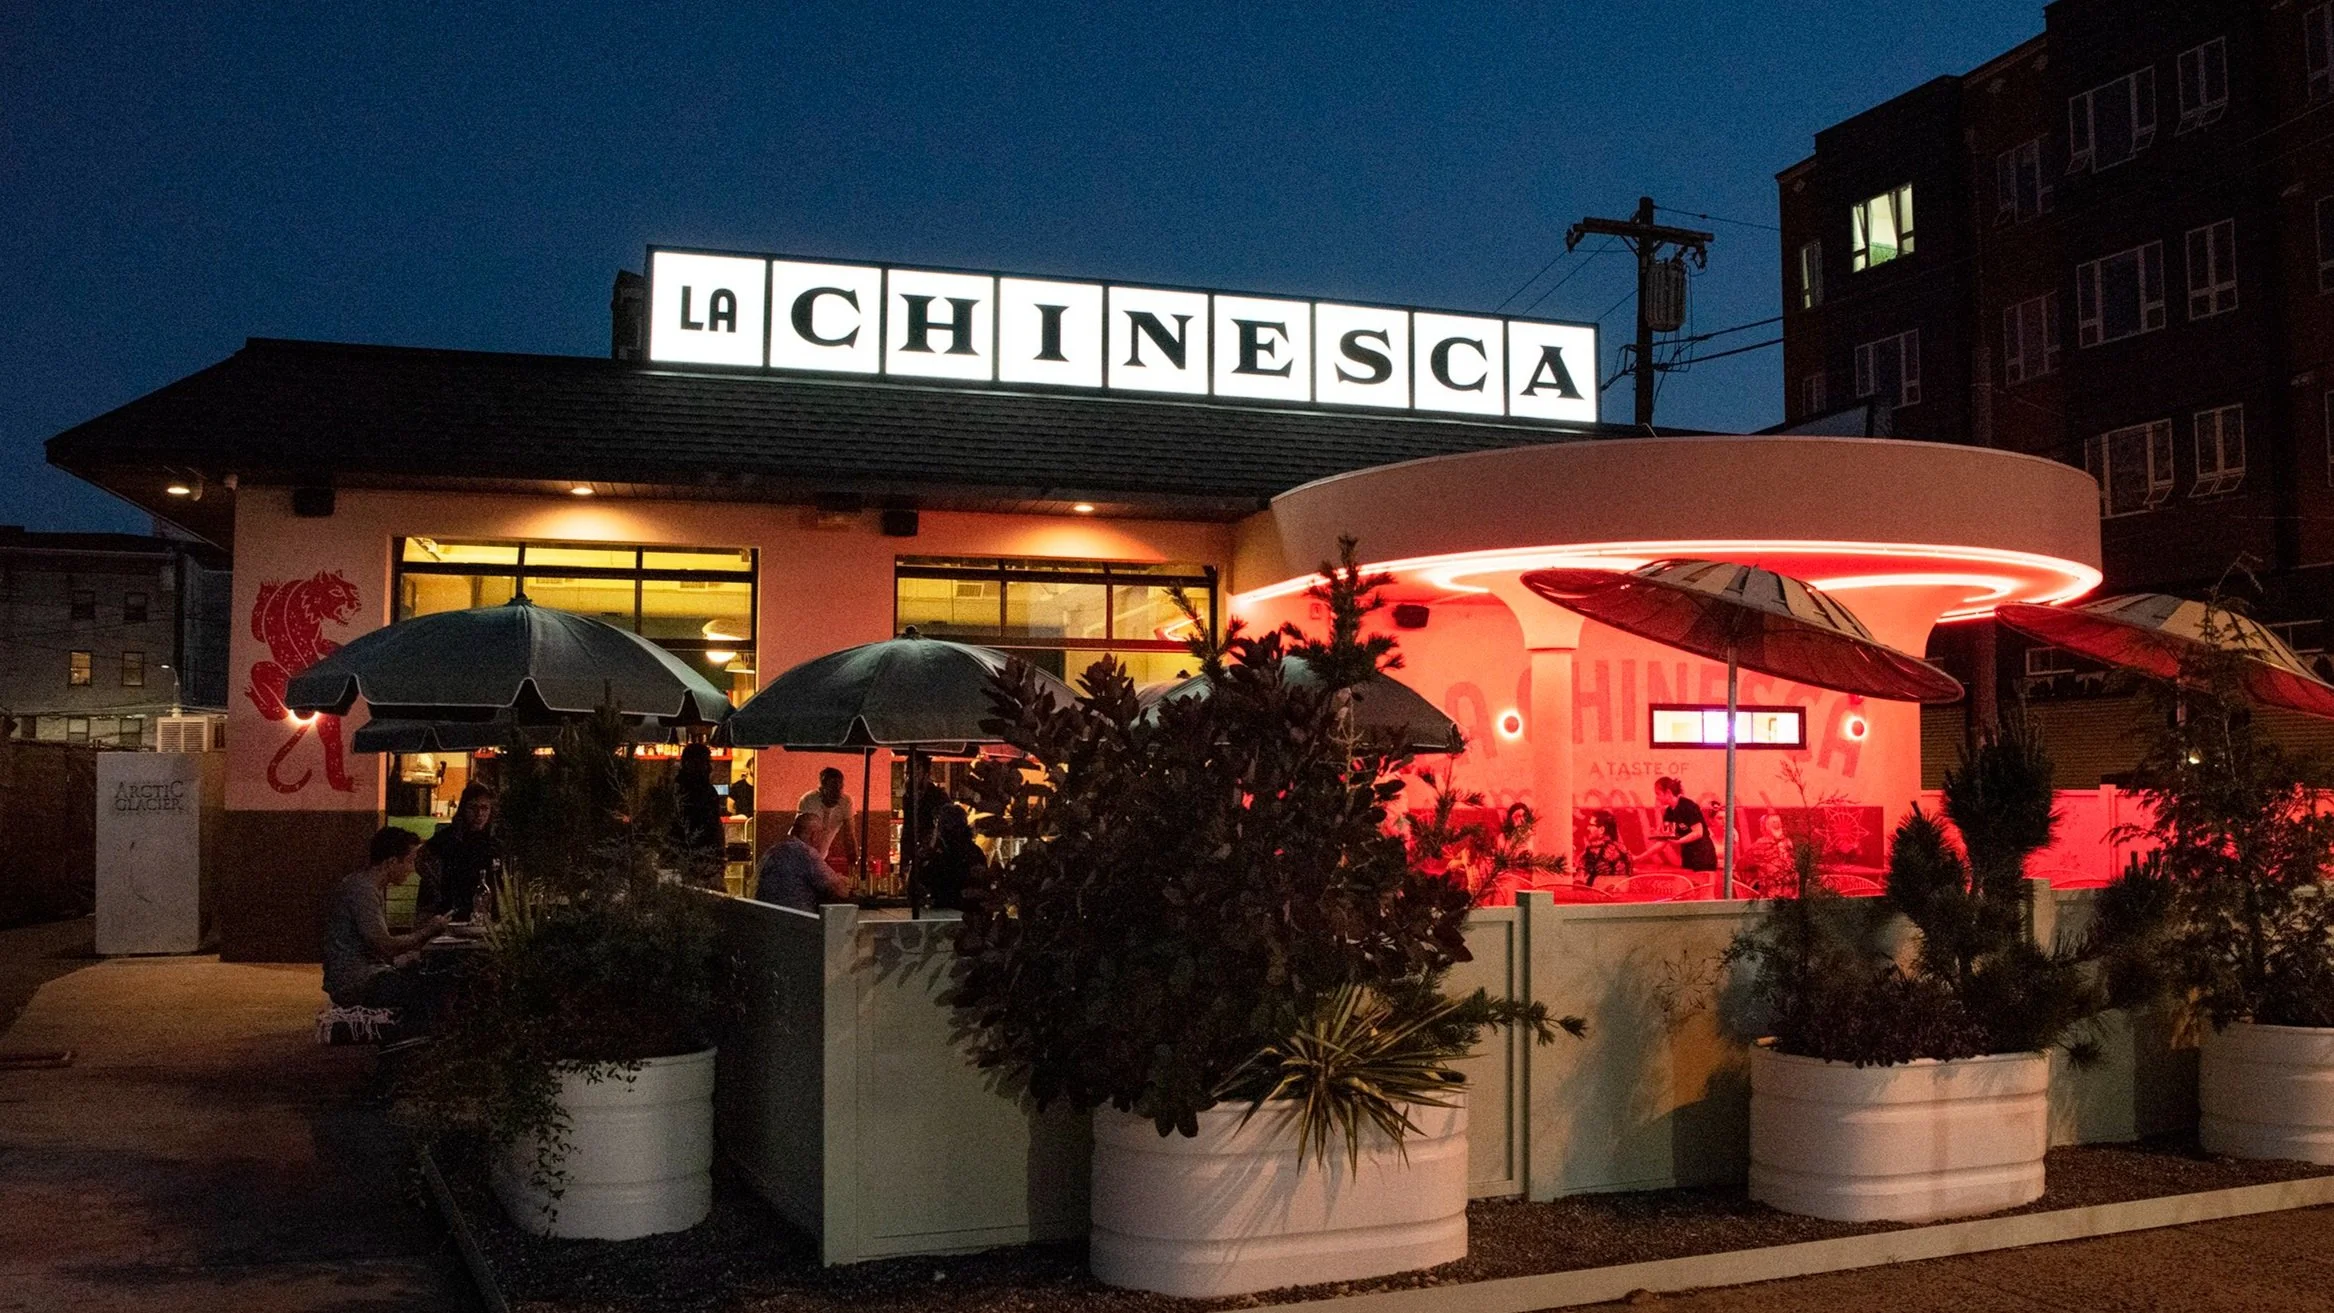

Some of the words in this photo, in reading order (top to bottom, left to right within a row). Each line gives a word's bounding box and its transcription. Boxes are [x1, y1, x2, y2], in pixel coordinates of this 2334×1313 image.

[680, 285, 737, 333] LA
[791, 286, 1585, 400] CHINESCA
[1516, 659, 1868, 778] HINCA
[1590, 762, 1603, 777] A
[1606, 762, 1664, 776] TASTE
[1668, 761, 1689, 775] OF
[114, 780, 184, 798] ARCTIC
[114, 798, 184, 812] GLACIER
